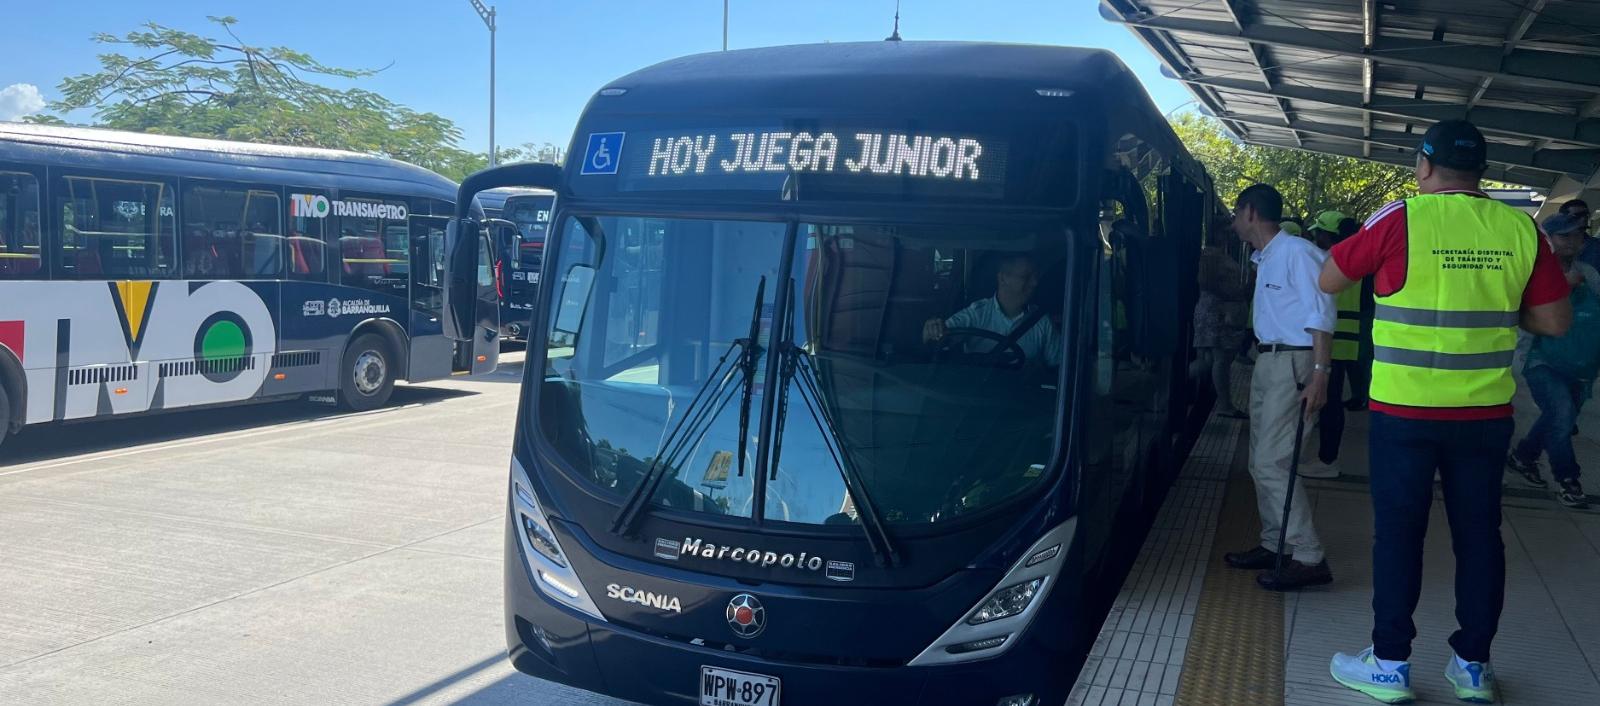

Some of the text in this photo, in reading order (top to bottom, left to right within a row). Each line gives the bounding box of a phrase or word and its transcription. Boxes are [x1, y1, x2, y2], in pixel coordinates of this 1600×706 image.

[648, 131, 983, 180] HOY JUEGA JUNIOR
[290, 193, 330, 218] TMO
[1477, 249, 1514, 257] DISTRITAL
[342, 304, 390, 315] BARRANQUILLA
[681, 536, 823, 571] Marcopolo
[606, 583, 682, 614] SCANIA
[704, 673, 777, 706] WPW-897
[1372, 673, 1400, 684] HOKA
